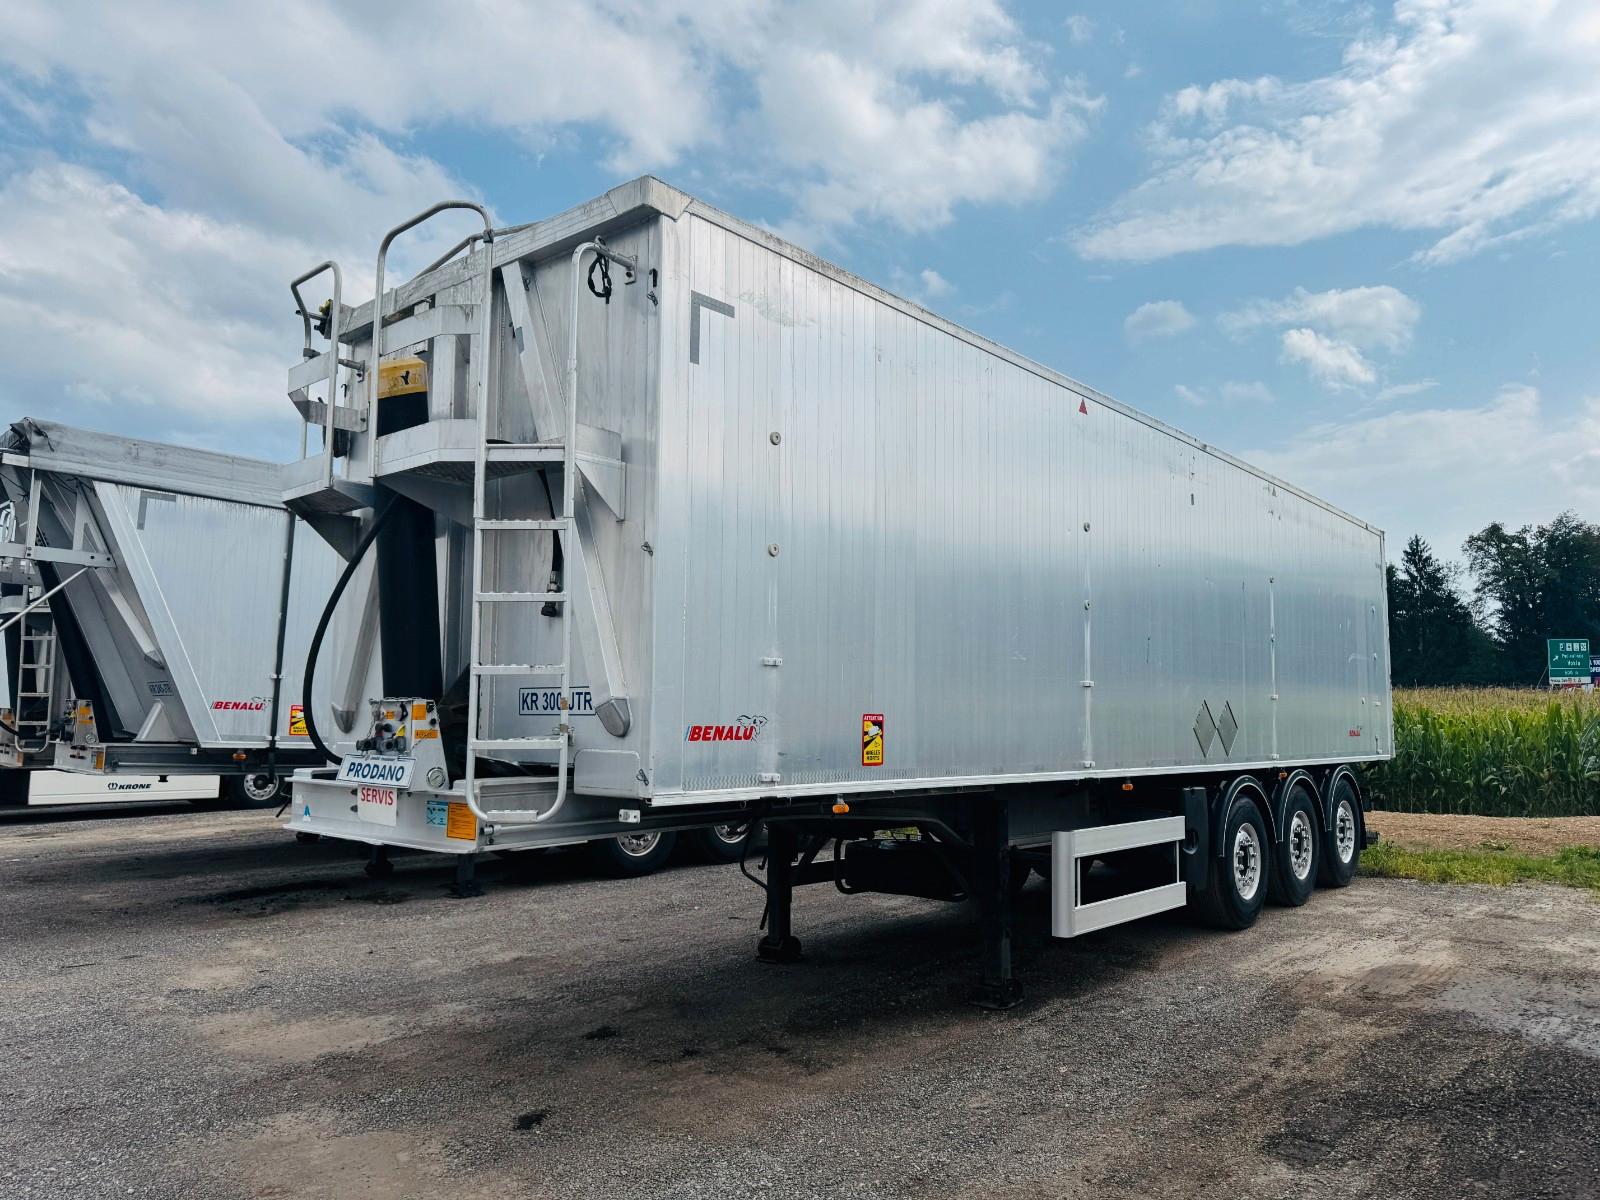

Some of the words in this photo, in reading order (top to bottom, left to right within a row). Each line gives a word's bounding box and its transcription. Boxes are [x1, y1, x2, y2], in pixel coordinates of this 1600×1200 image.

[213, 701, 264, 711] BENALU
[521, 692, 539, 711] KR
[542, 692, 562, 711] 300
[568, 691, 593, 711] JTR
[688, 725, 753, 741] BENALU
[346, 762, 405, 782] PRODANO
[360, 786, 394, 806] SERVIS
